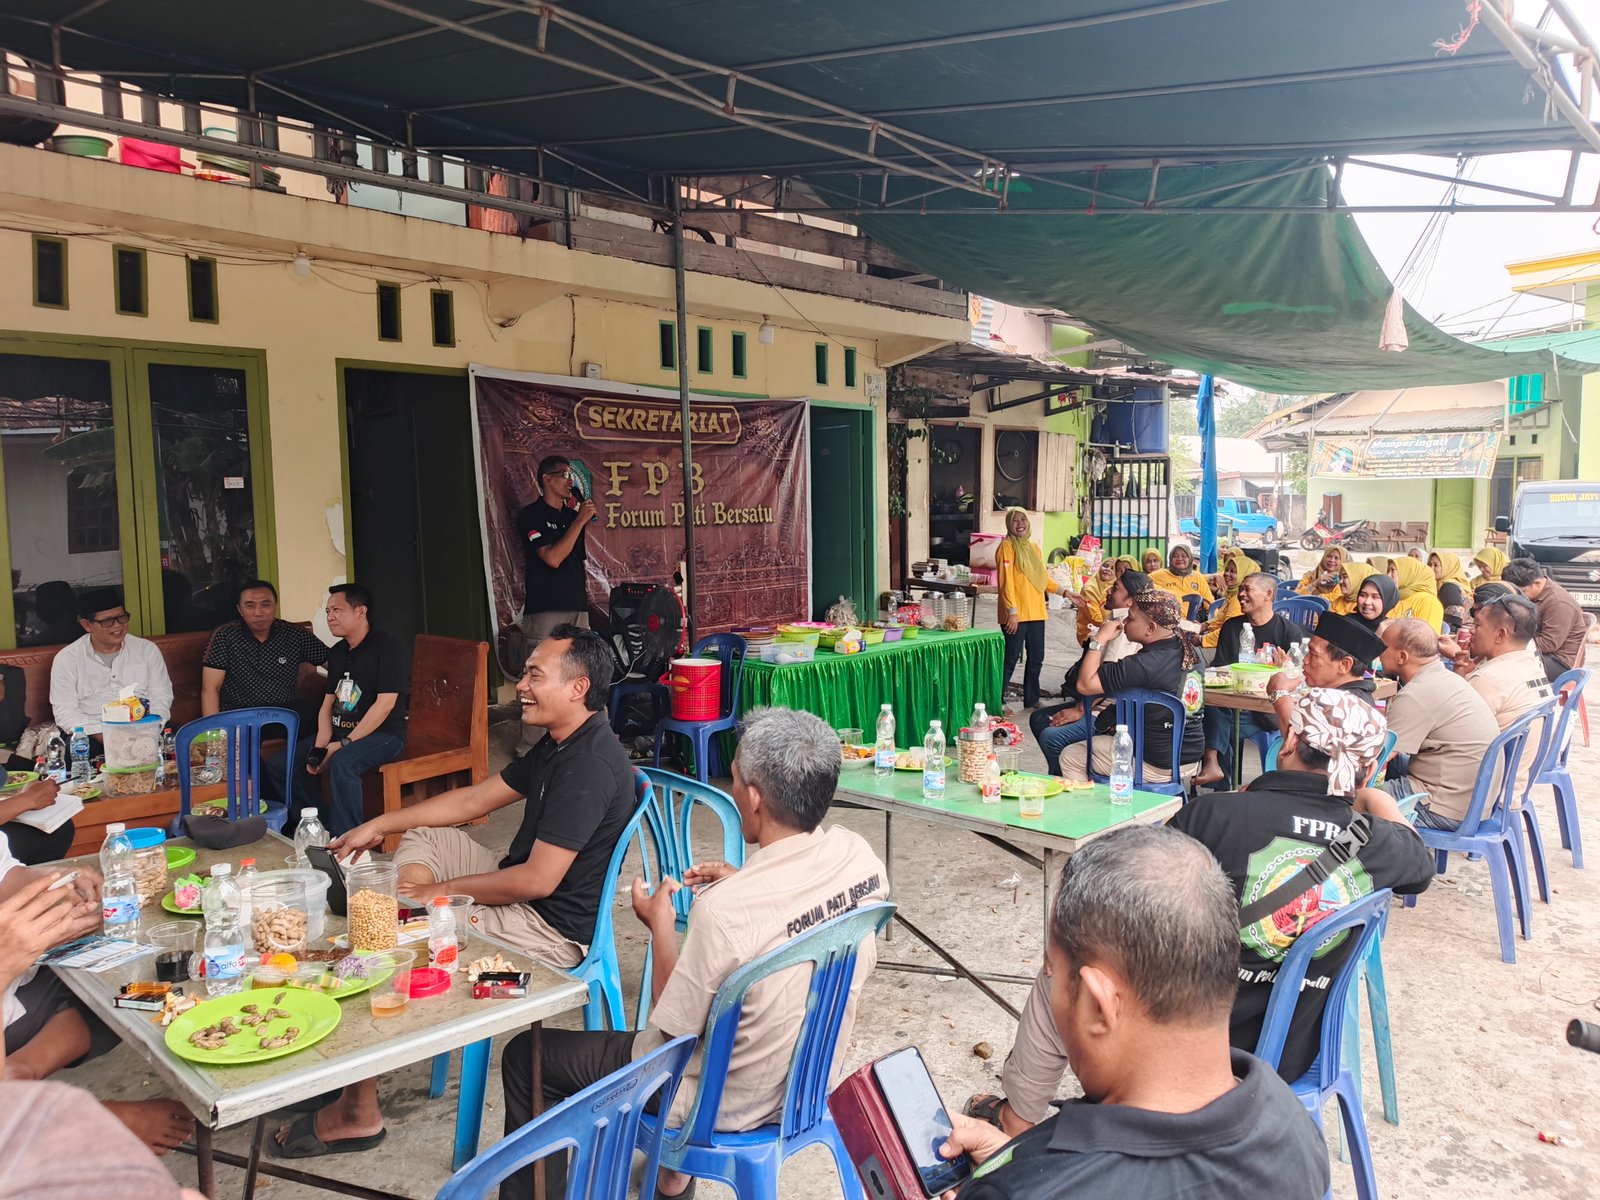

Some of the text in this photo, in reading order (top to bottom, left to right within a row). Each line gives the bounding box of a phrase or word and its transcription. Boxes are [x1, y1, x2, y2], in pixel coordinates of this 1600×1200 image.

[588, 406, 732, 434] SEKRETARIAT
[605, 501, 774, 528] Forum Pti Bersatu
[786, 904, 825, 938] FORUM
[826, 890, 847, 915] PATI
[848, 873, 881, 903] BERSATU
